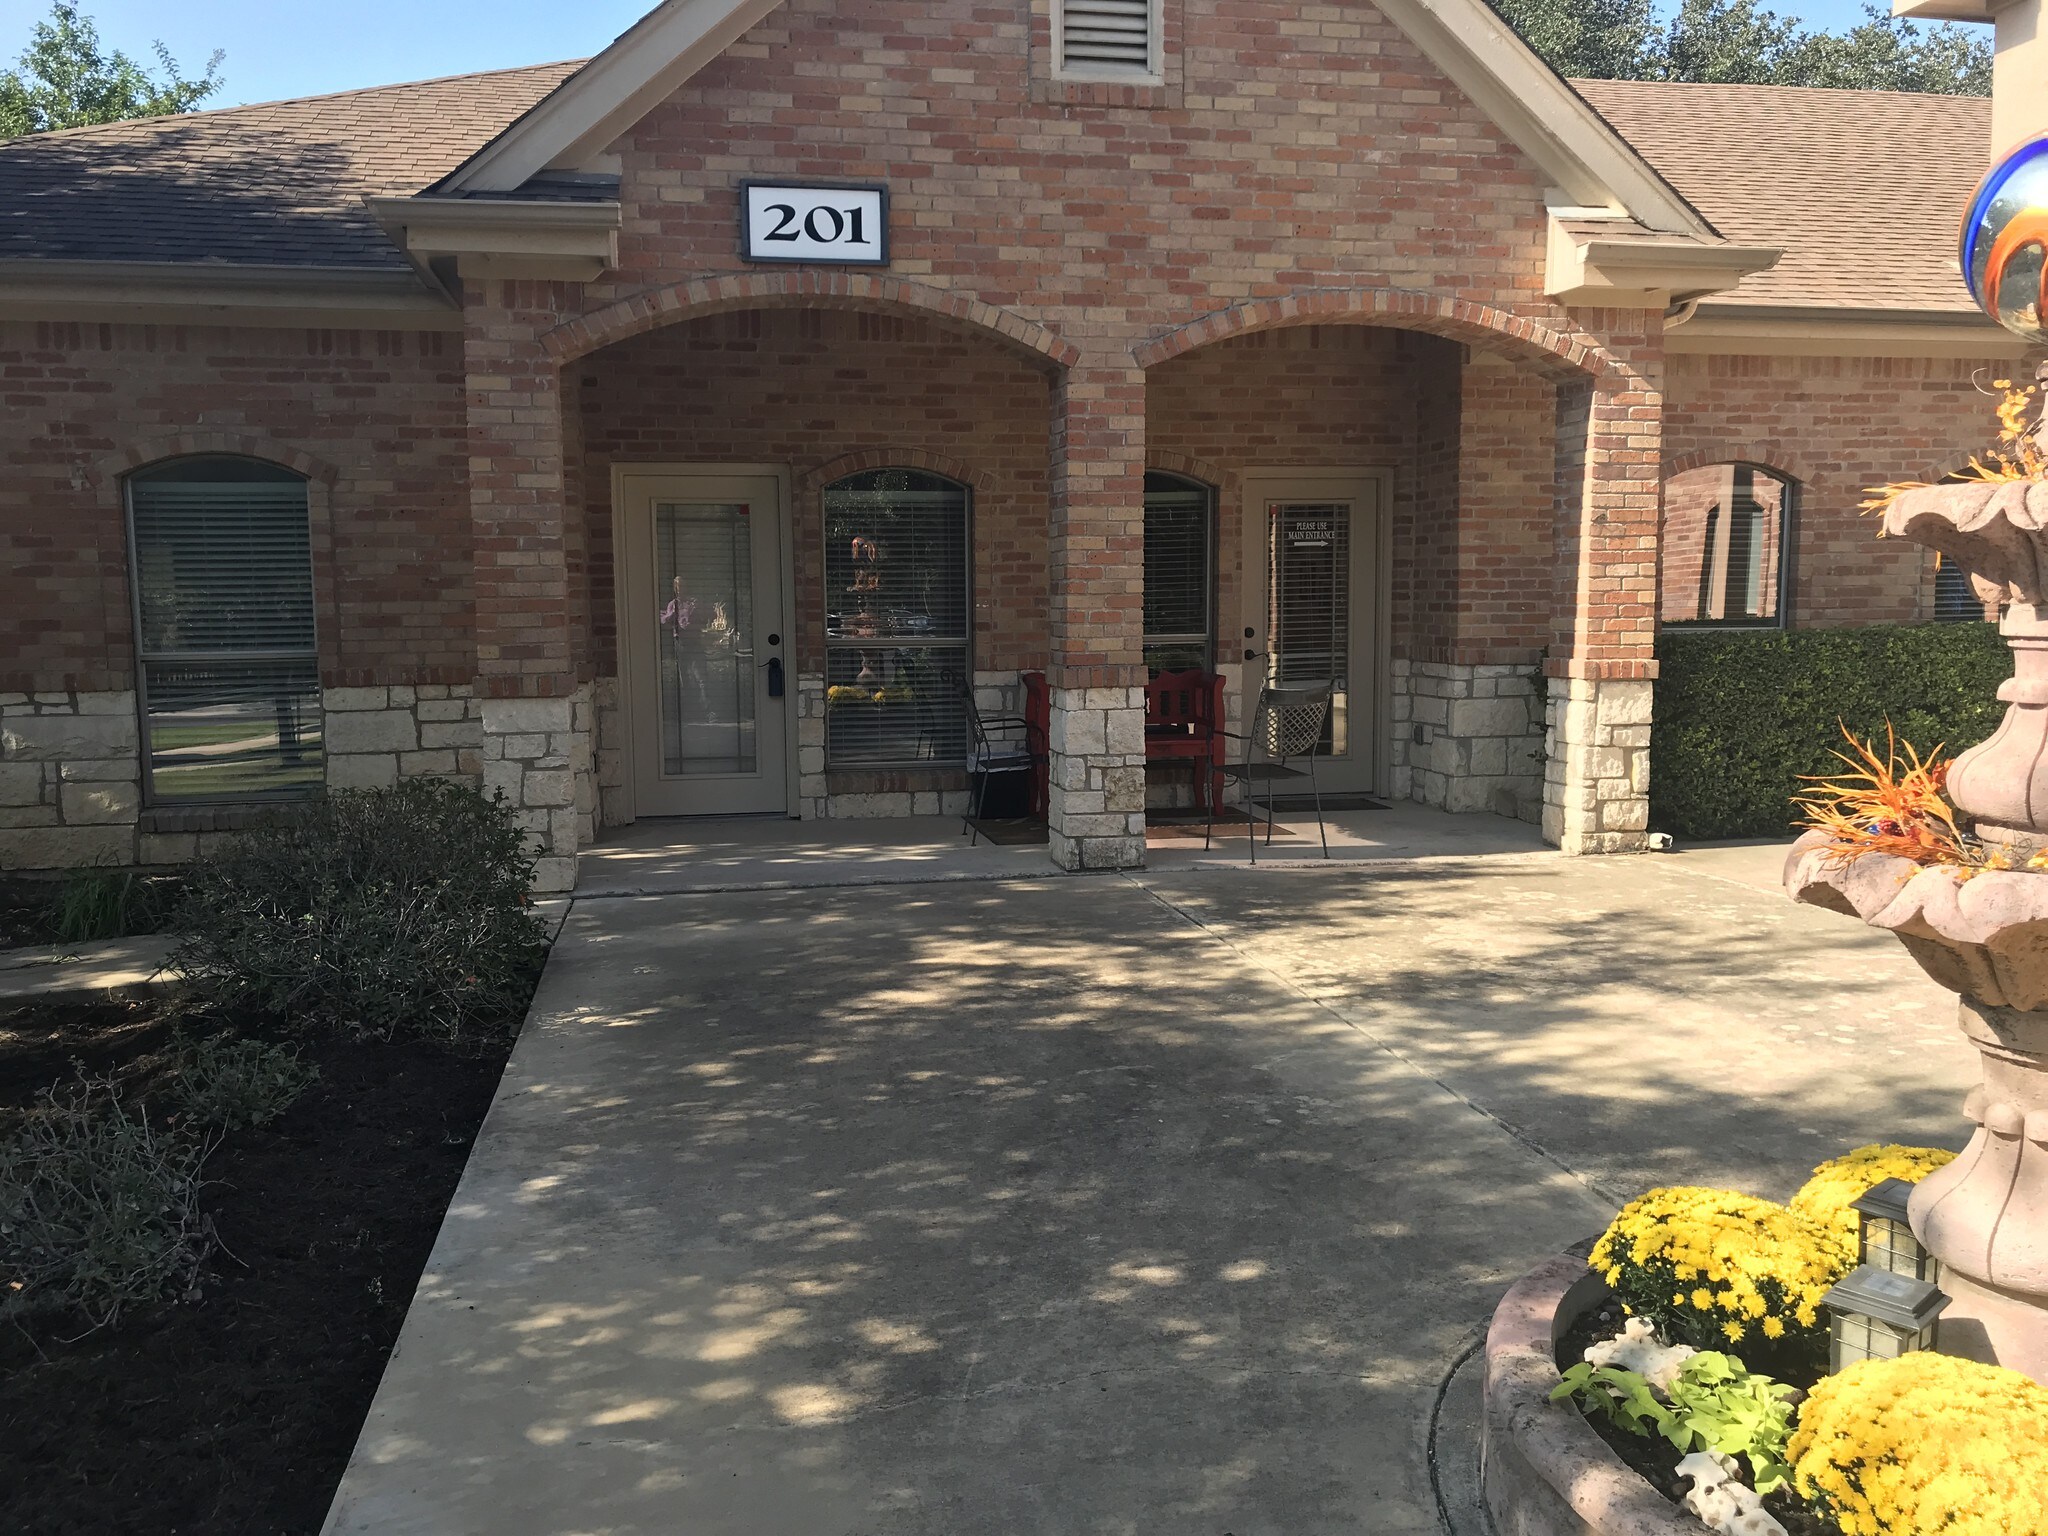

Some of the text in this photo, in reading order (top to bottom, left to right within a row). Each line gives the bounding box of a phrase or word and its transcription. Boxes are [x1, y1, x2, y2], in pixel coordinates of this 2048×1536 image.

[763, 204, 871, 244] 201
[1296, 522, 1327, 530] PLEASE USE
[1288, 531, 1335, 539] MAIN ENTRANCE
